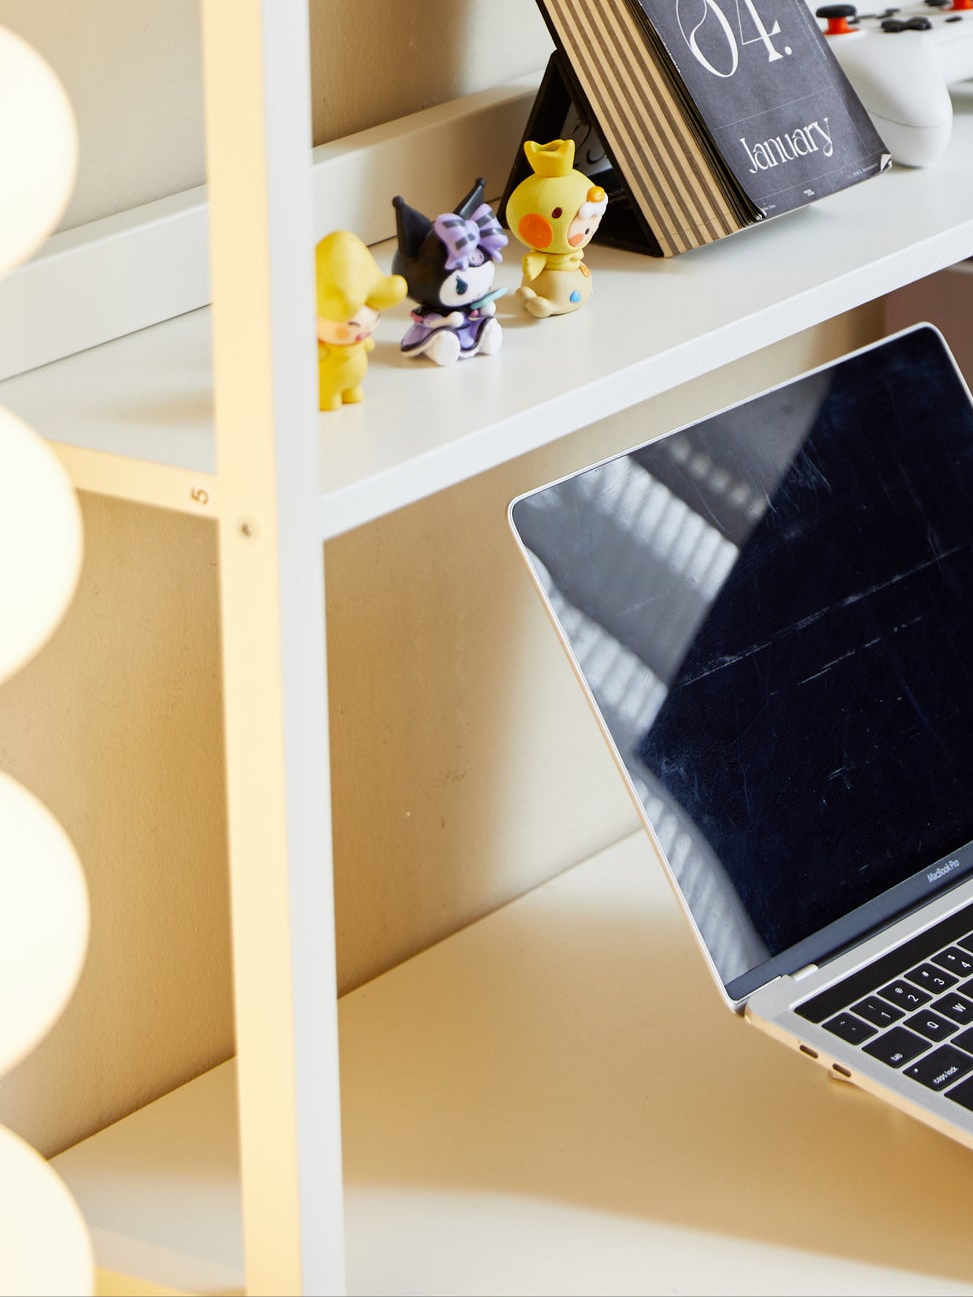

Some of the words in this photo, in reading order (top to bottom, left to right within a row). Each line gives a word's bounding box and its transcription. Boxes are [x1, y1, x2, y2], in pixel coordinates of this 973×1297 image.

[740, 117, 833, 174] January
[927, 863, 953, 883] MacBook
[949, 859, 960, 870] Pro
[933, 977, 945, 986] 3
[907, 994, 919, 1003] 2
[951, 1002, 967, 1013] W
[926, 1021, 940, 1029] Q
[890, 1053, 903, 1062] tab
[933, 1073, 949, 1084] caps
[944, 1066, 959, 1076] lock
